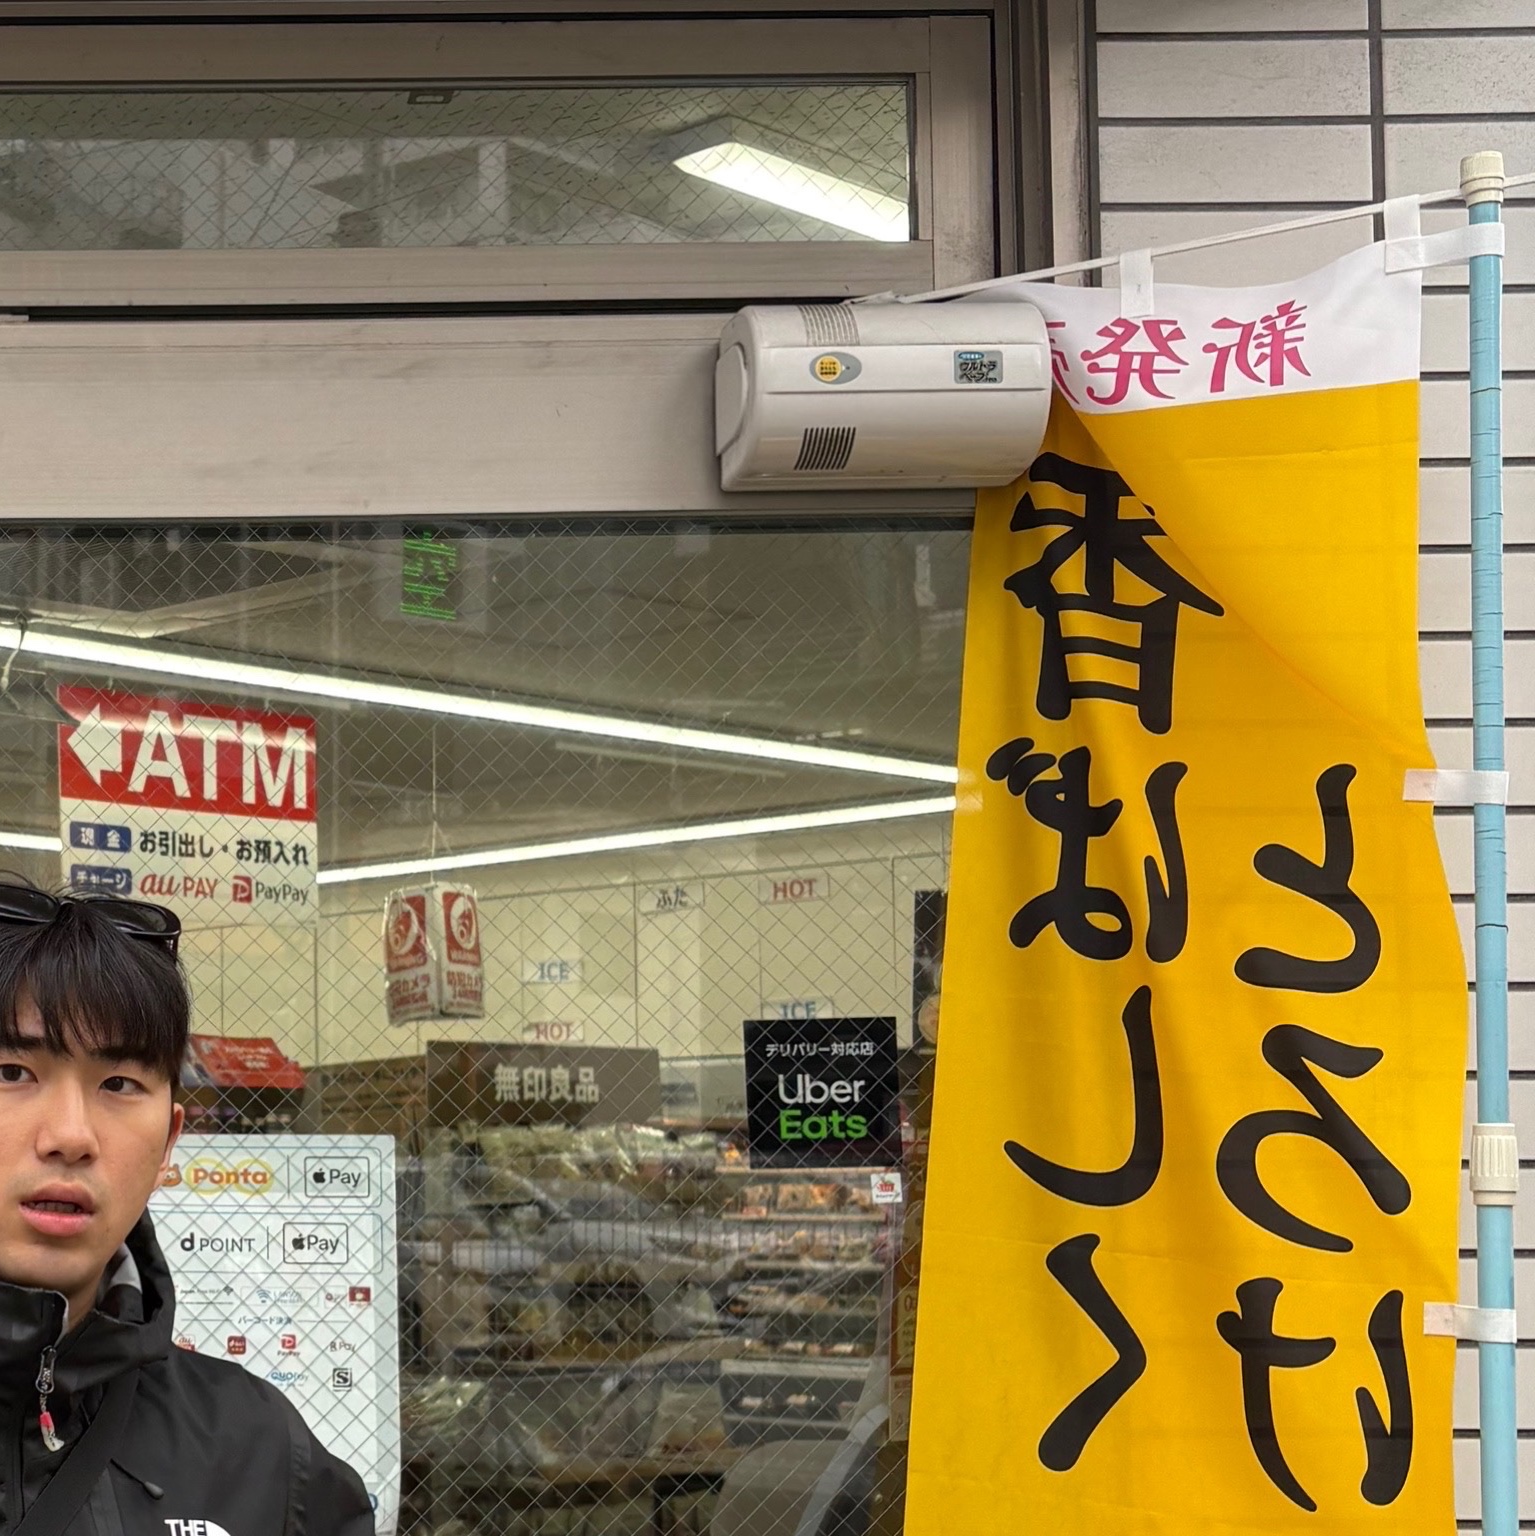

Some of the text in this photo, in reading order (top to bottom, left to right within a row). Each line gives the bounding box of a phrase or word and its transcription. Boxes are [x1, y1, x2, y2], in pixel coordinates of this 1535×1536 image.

[128, 710, 306, 809] ATM
[80, 827, 309, 866] 現金 お引出し・お預入れ
[140, 874, 309, 905] au PAY PayPay
[774, 878, 816, 900] HOT
[537, 961, 569, 982] ICE
[532, 1022, 574, 1041] HOT
[765, 1042, 874, 1057] デリバリー対応店
[493, 1064, 600, 1103] 無印良品
[778, 1074, 865, 1104] Uber
[779, 1109, 868, 1140] Eats
[193, 1168, 362, 1189] Ponta Pay
[199, 1238, 256, 1253] POINT
[308, 1237, 340, 1255] Pay
[238, 1315, 292, 1325] バーコード決済
